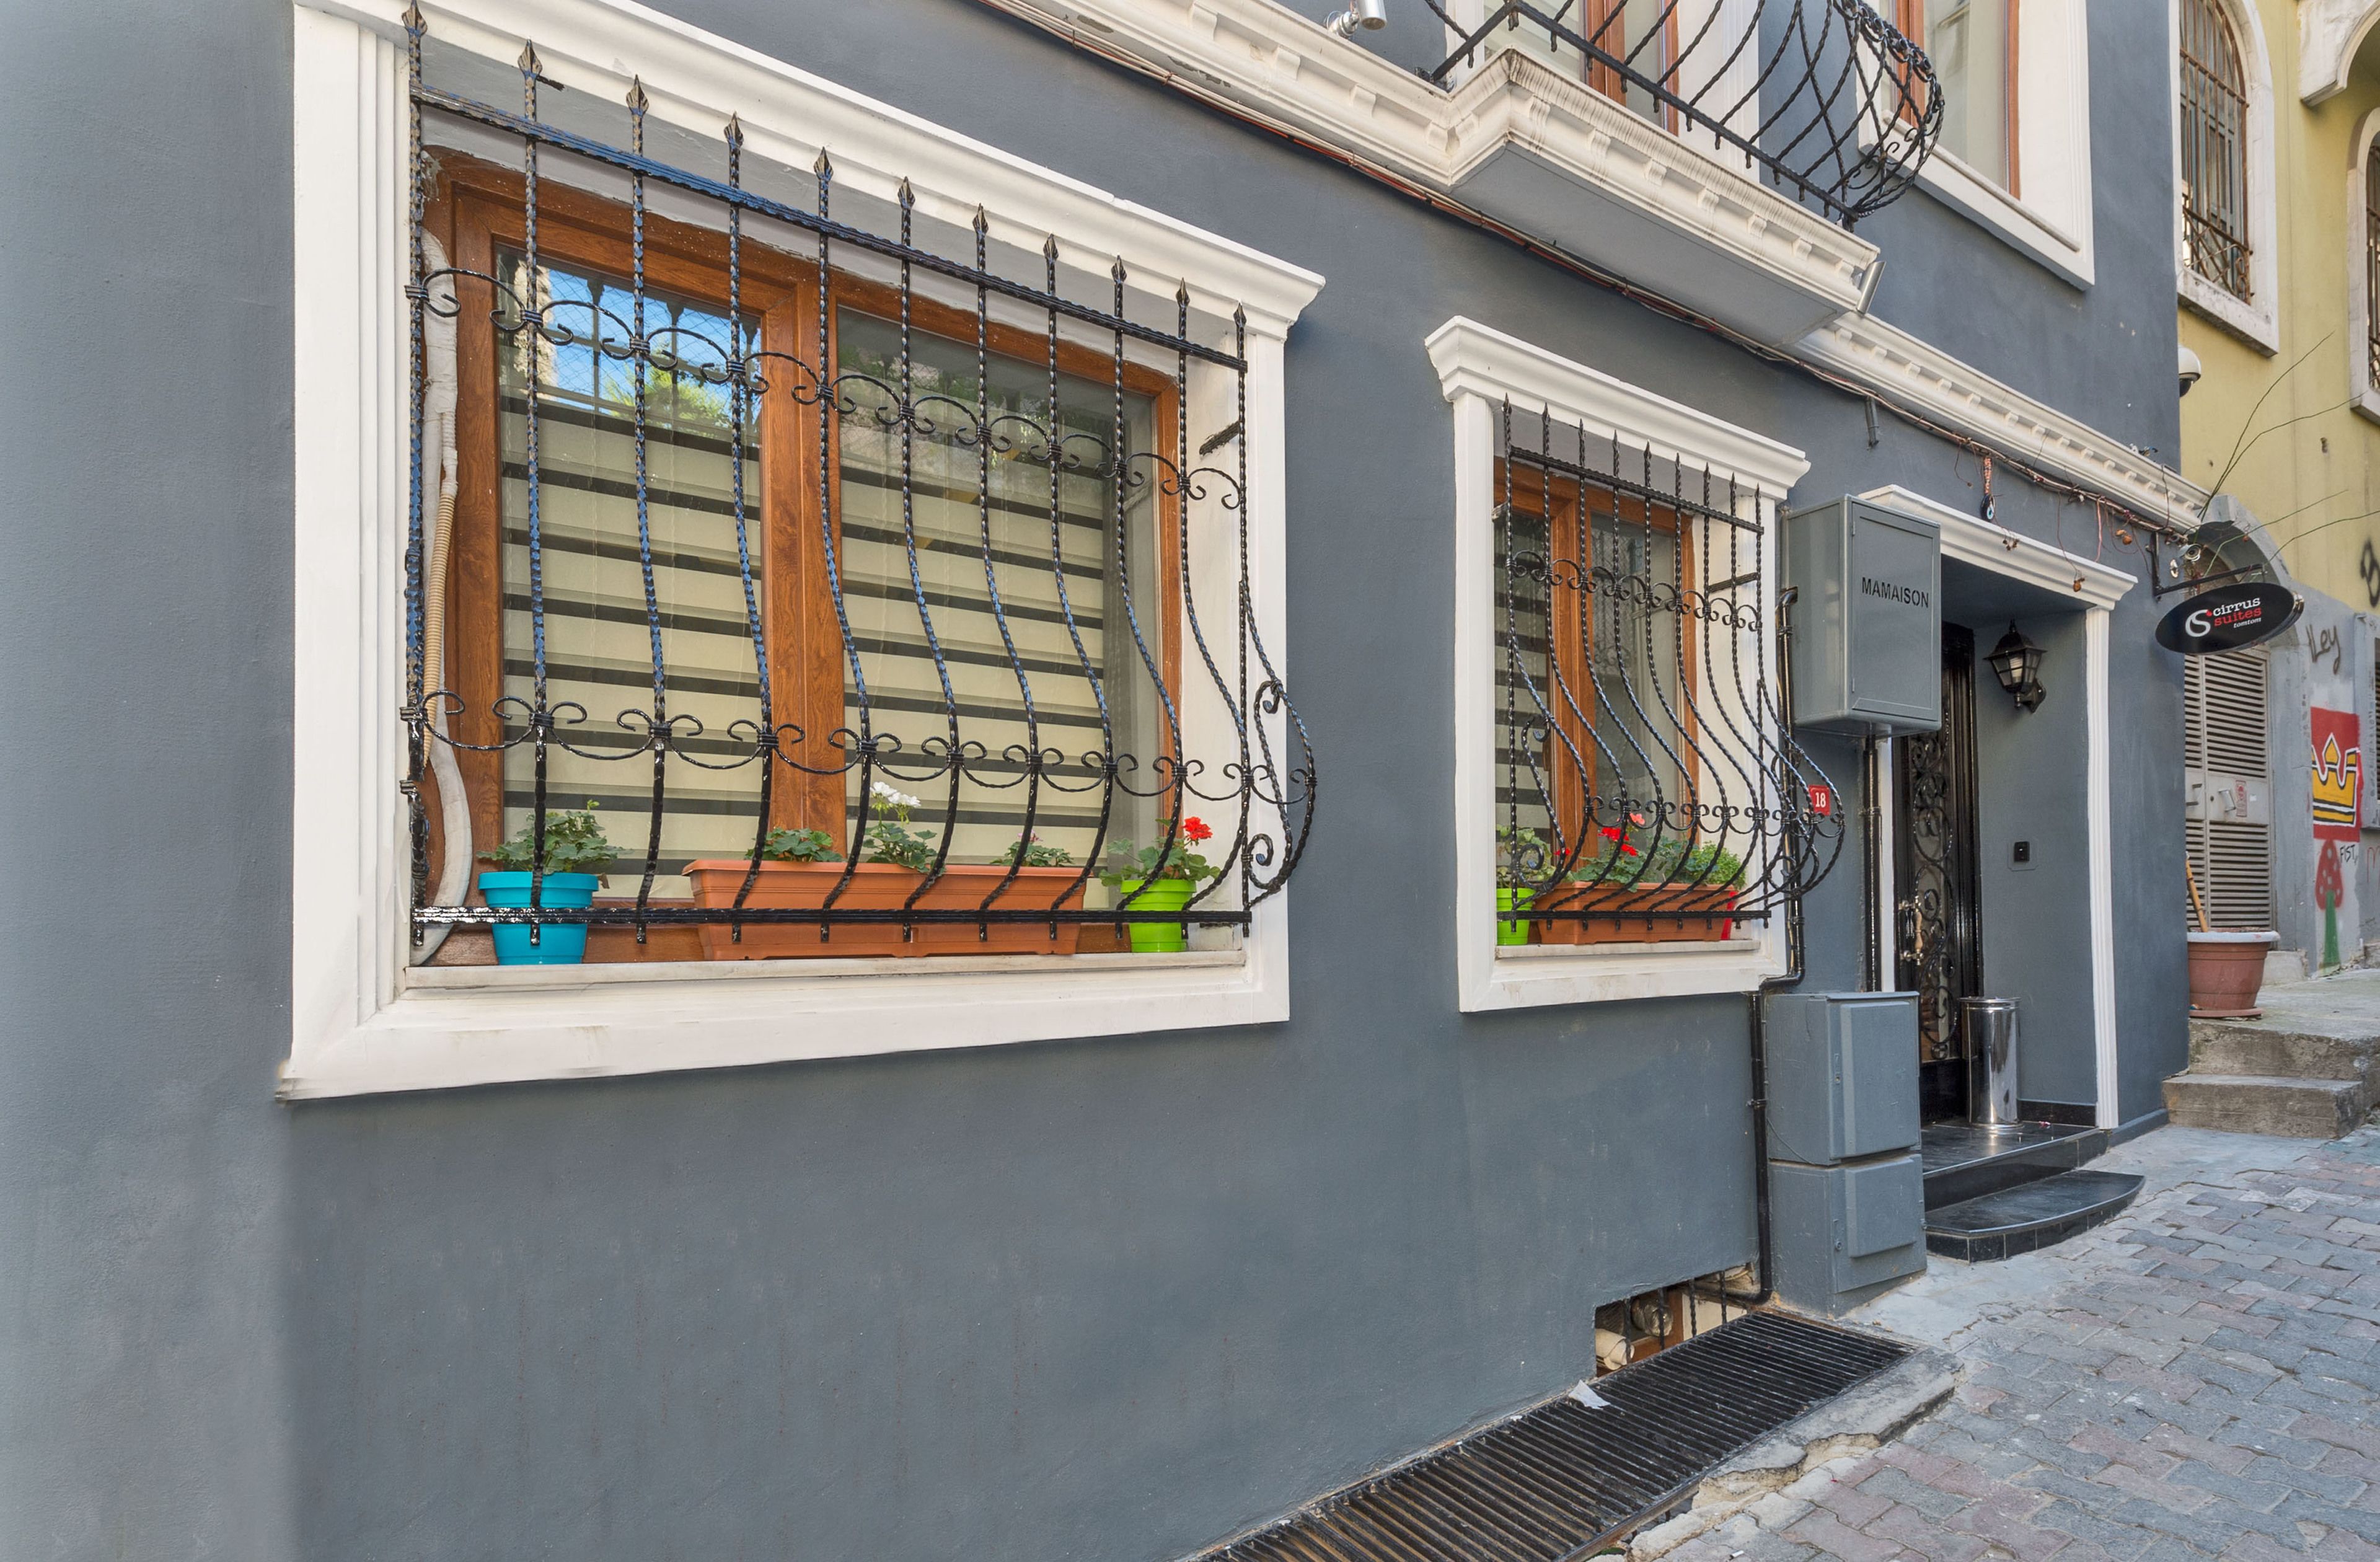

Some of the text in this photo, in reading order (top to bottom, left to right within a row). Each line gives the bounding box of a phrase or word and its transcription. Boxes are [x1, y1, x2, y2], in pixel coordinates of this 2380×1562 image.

[1862, 576, 1929, 608] MAMAISON
[2213, 597, 2261, 617] cirrus
[2214, 607, 2262, 627] suites
[2233, 617, 2262, 629] tomtom
[1815, 792, 1827, 808] 18
